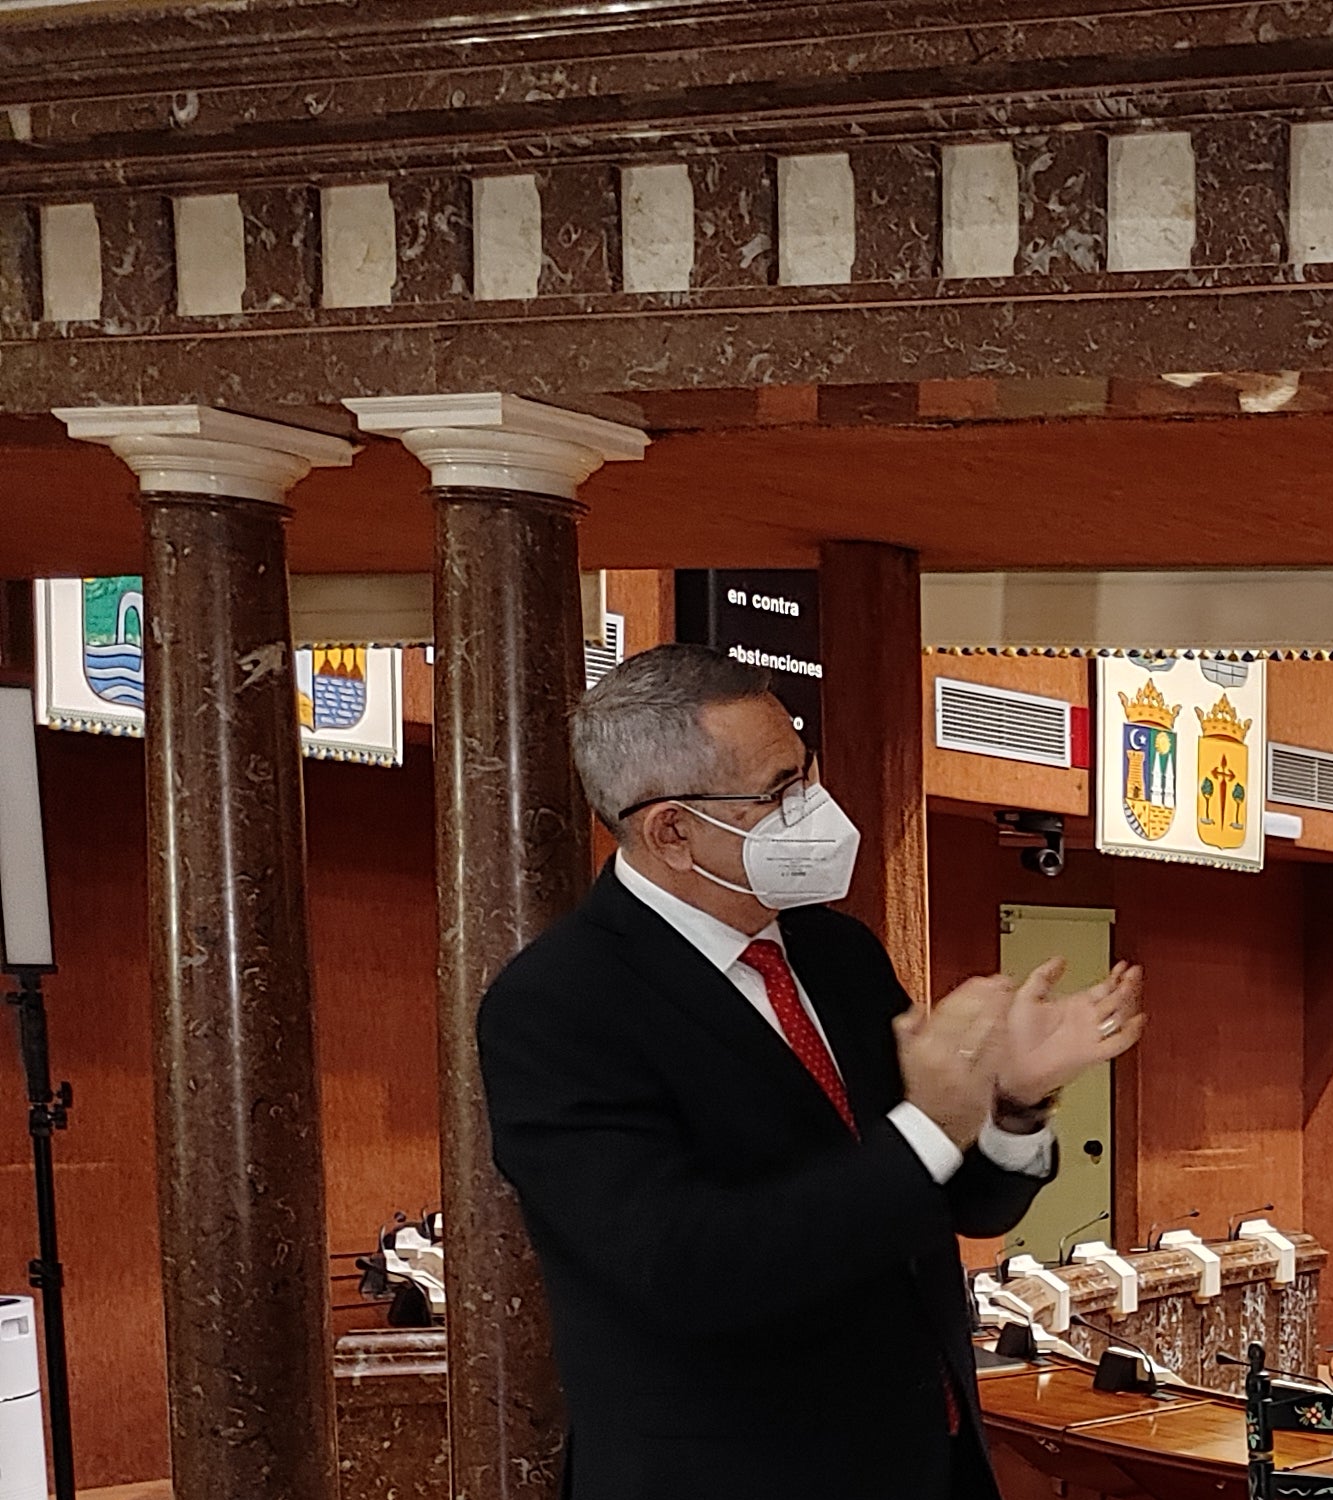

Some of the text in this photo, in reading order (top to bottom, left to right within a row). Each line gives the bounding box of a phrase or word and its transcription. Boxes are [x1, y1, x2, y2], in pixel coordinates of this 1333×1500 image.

[727, 588, 800, 617] en contra
[727, 644, 823, 679] abstenciones
